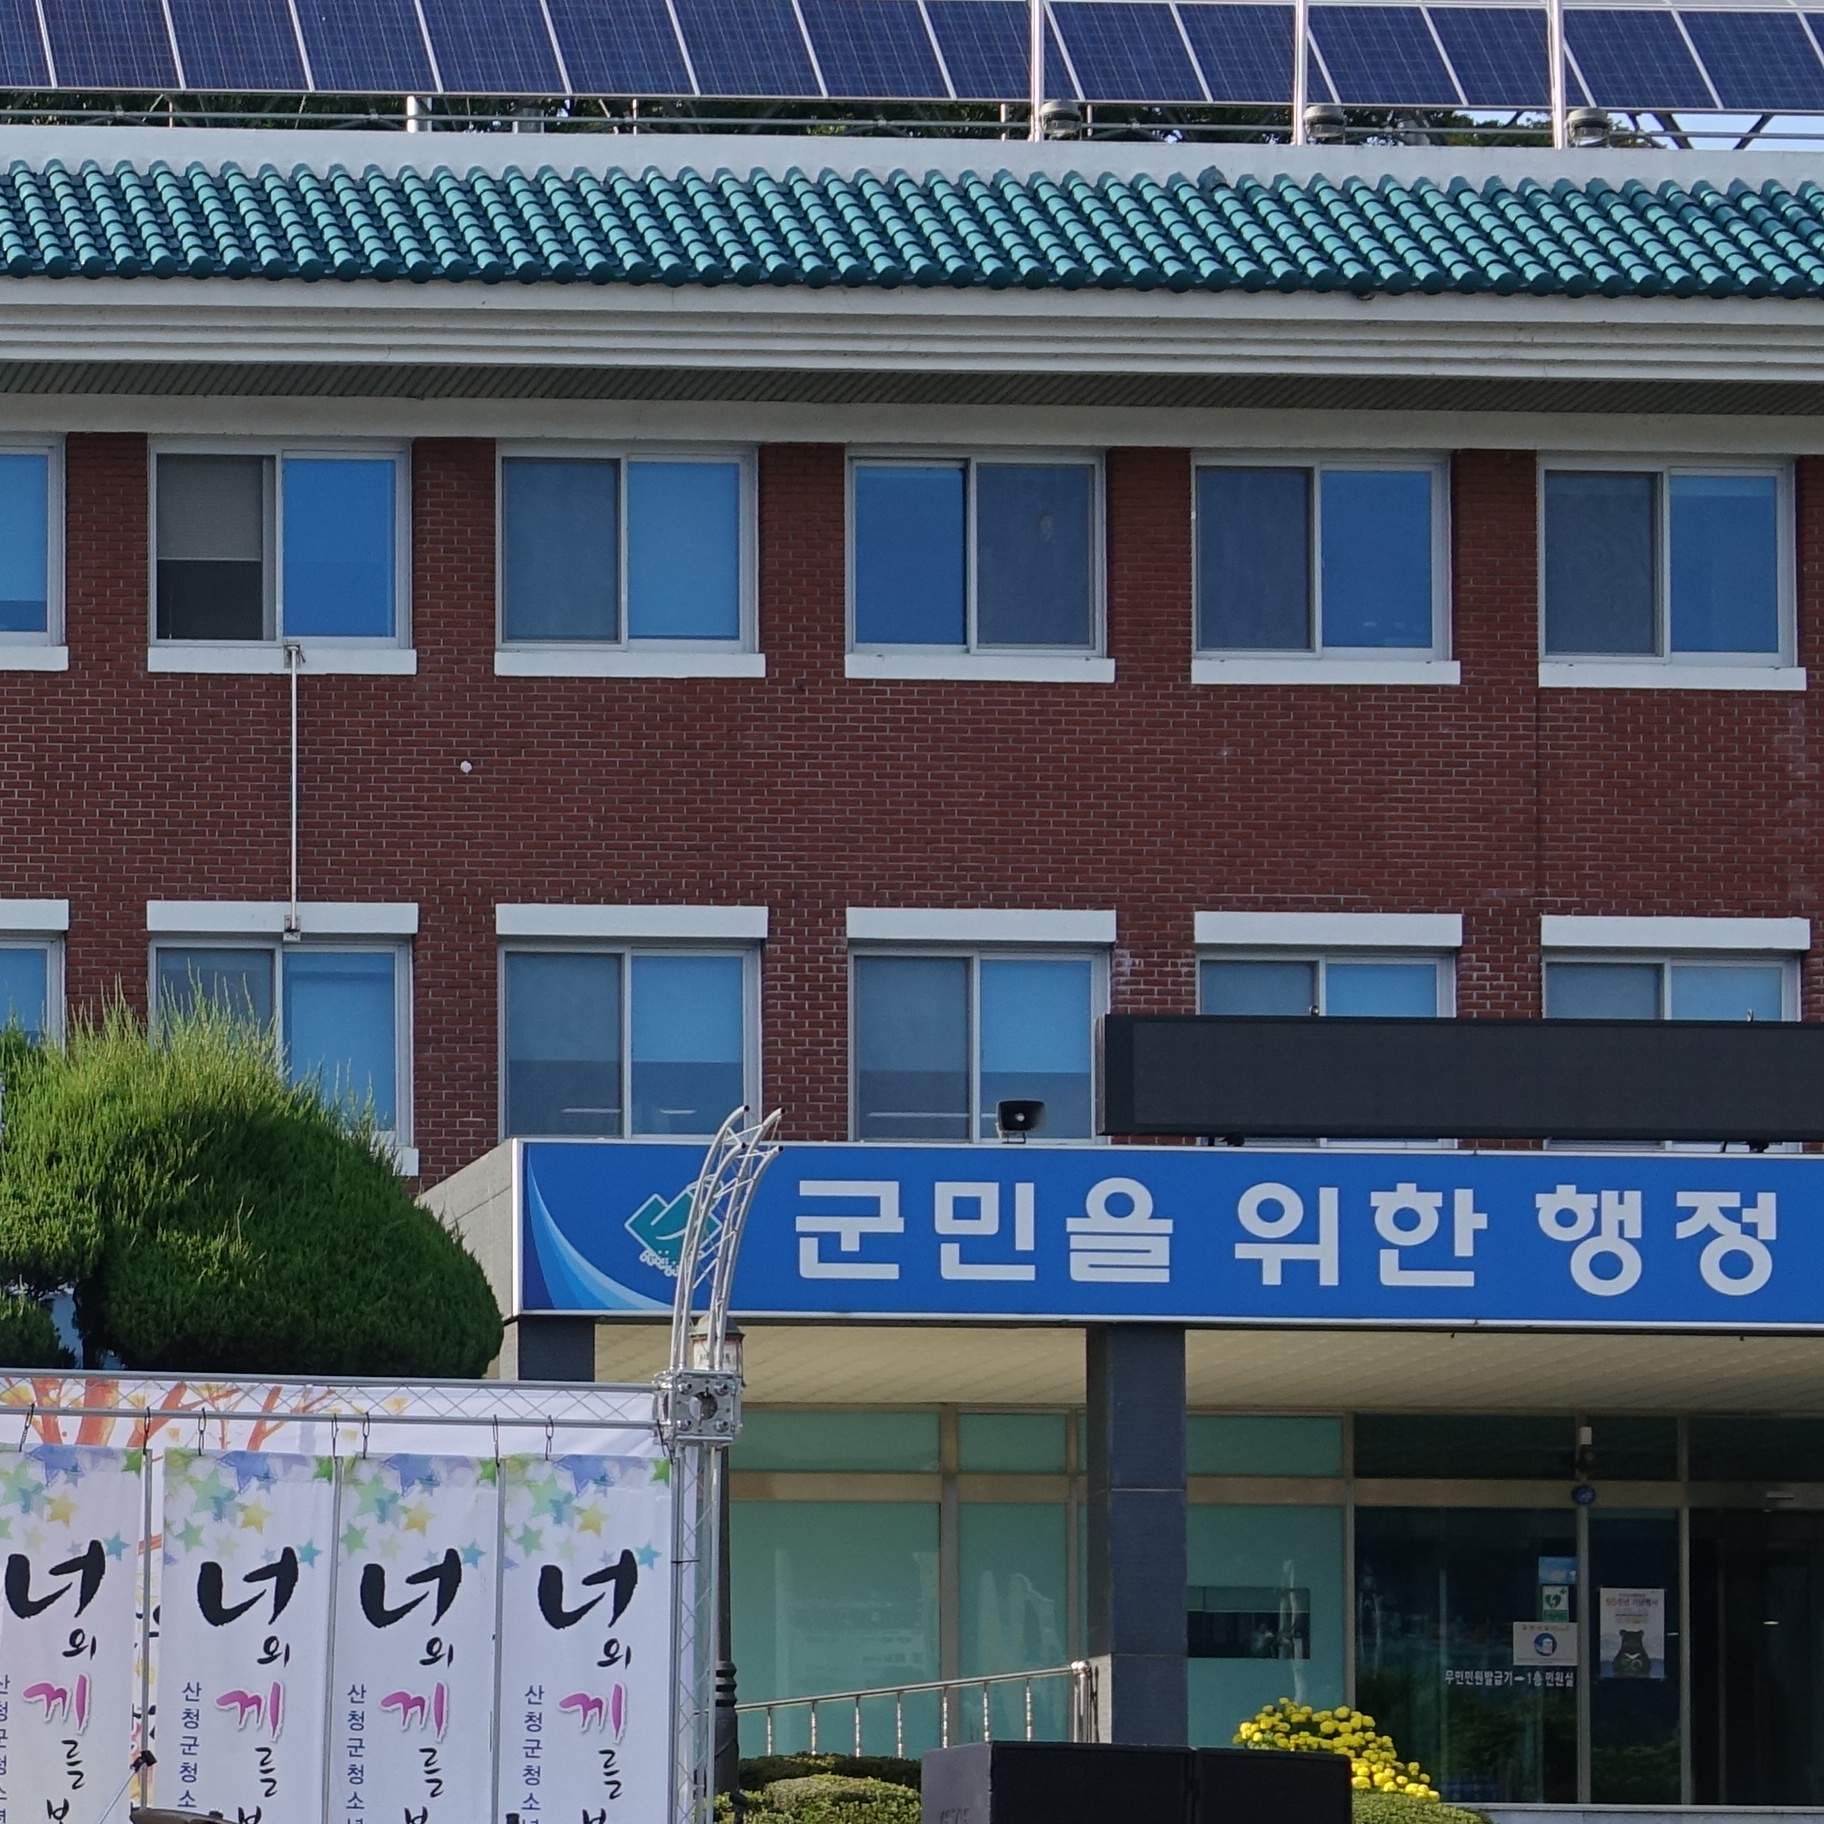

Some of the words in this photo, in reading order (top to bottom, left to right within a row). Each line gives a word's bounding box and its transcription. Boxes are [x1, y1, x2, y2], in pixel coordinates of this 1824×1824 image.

[795, 1178, 1174, 1284] 군민을
[1234, 1182, 1489, 1289] 위한
[1537, 1184, 1780, 1299] 행정
[5, 1539, 106, 1661] 너의
[198, 1547, 299, 1667] 너의
[360, 1549, 463, 1667] 너의
[537, 1549, 638, 1667] 너의
